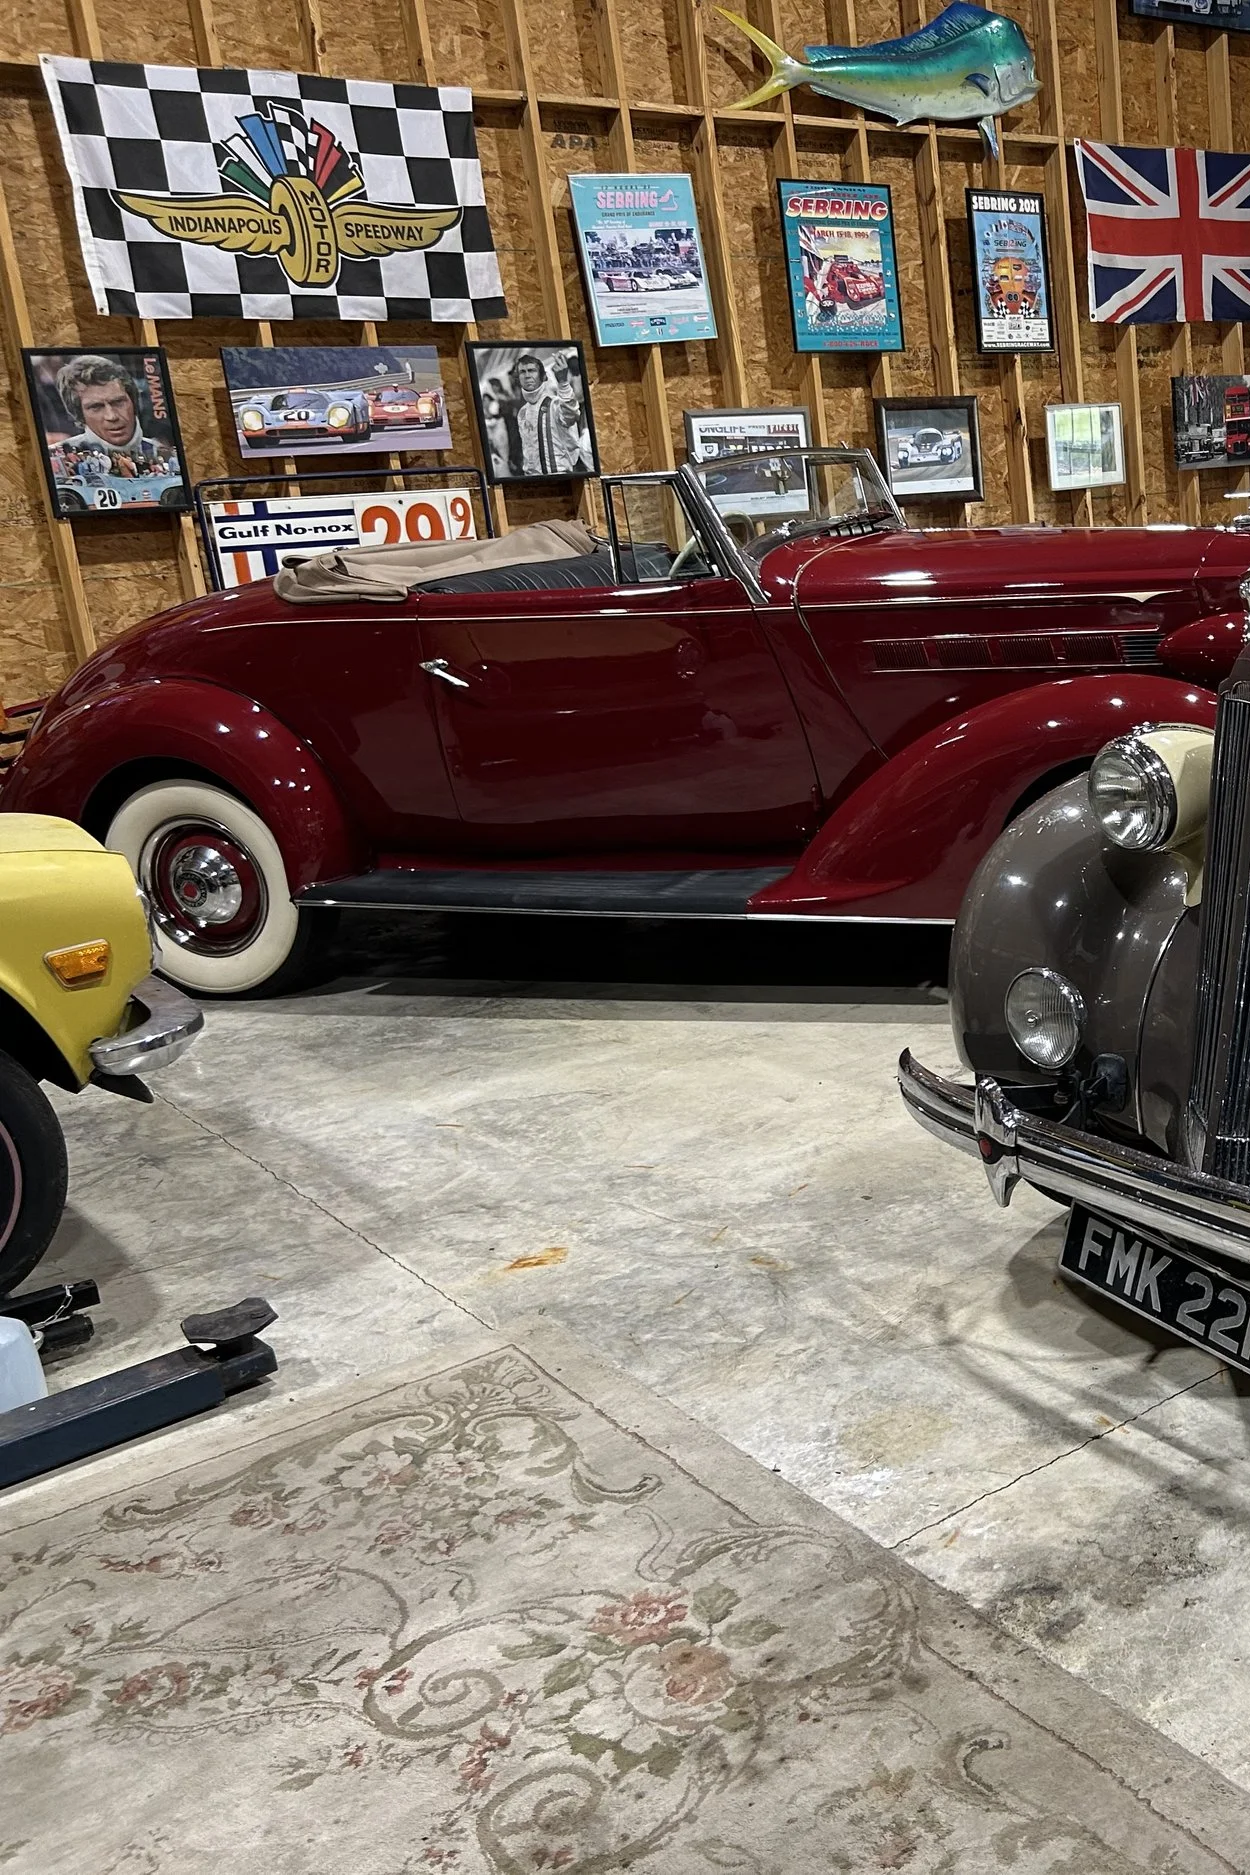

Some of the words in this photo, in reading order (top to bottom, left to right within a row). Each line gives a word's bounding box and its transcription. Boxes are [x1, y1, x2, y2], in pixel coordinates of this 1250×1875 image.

[596, 190, 658, 209] SEBRING
[785, 196, 889, 221] SEBRING
[972, 195, 1017, 212] SEBRING
[1019, 199, 1040, 213] 2021
[168, 215, 283, 236] INDIANAPOLIS
[300, 190, 331, 273] MOTOR
[344, 222, 425, 242] SPEEDWAY
[284, 409, 310, 421] 20
[99, 489, 118, 508] 20
[450, 496, 471, 537] 9
[218, 525, 270, 540] Gulf
[276, 522, 354, 537] No-nox
[1078, 1217, 1173, 1313] FMK
